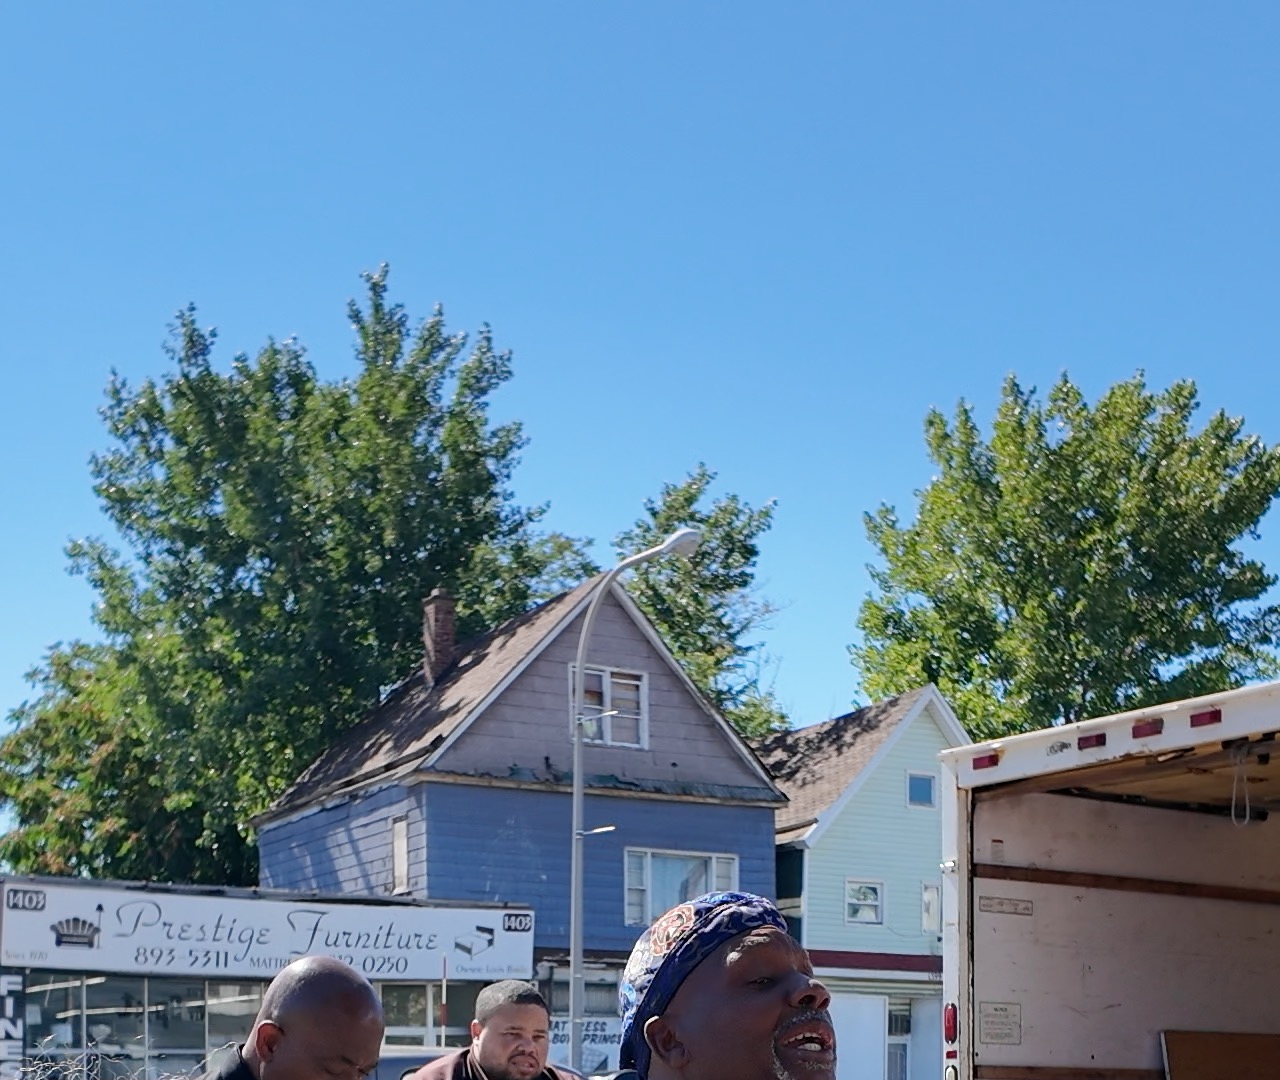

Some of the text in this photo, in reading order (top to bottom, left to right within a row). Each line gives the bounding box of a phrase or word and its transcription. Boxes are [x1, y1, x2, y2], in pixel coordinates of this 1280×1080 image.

[7, 890, 46, 911] 1403
[112, 899, 439, 963] Prestige Furniture
[504, 914, 532, 931] 1403
[133, 946, 229, 969] 893-5311
